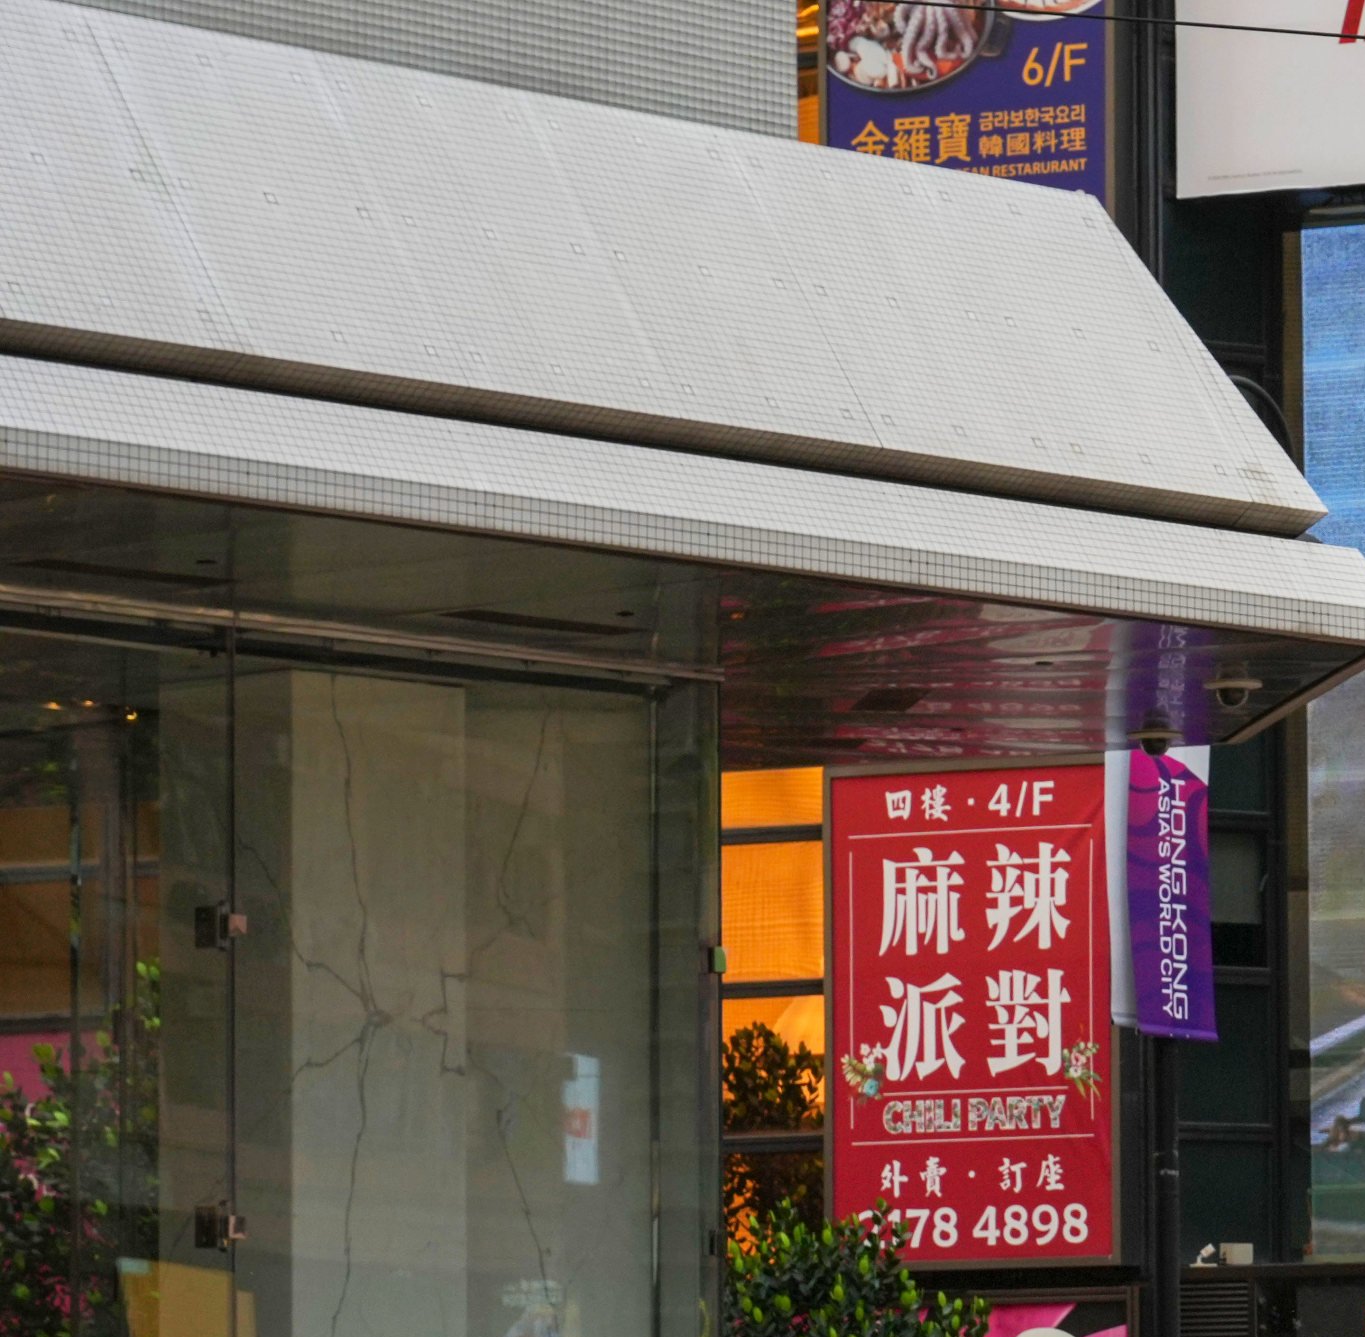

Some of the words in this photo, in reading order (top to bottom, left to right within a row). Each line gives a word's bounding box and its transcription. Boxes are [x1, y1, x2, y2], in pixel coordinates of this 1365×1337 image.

[1022, 42, 1088, 87] 6/F
[979, 105, 1086, 131] 금라보한국요리
[979, 127, 1087, 158] 韓國料理
[993, 158, 1087, 178] RESTARURANT
[885, 785, 952, 823] 四樓
[988, 780, 1056, 818] 4/F
[1158, 777, 1172, 858] ASIA'S
[1170, 778, 1187, 895] HONG
[879, 842, 1072, 957] 麻辣
[1158, 863, 1173, 954] WORLD
[1172, 903, 1189, 1020] KONG
[1160, 955, 1174, 1018] CITY
[879, 968, 1072, 1083] 派對
[883, 1098, 961, 1134] CHILI
[968, 1094, 1067, 1130] PARTY
[879, 1156, 948, 1198] 外賣
[998, 1154, 1066, 1193] 訂座
[972, 1203, 1089, 1247] 4898
